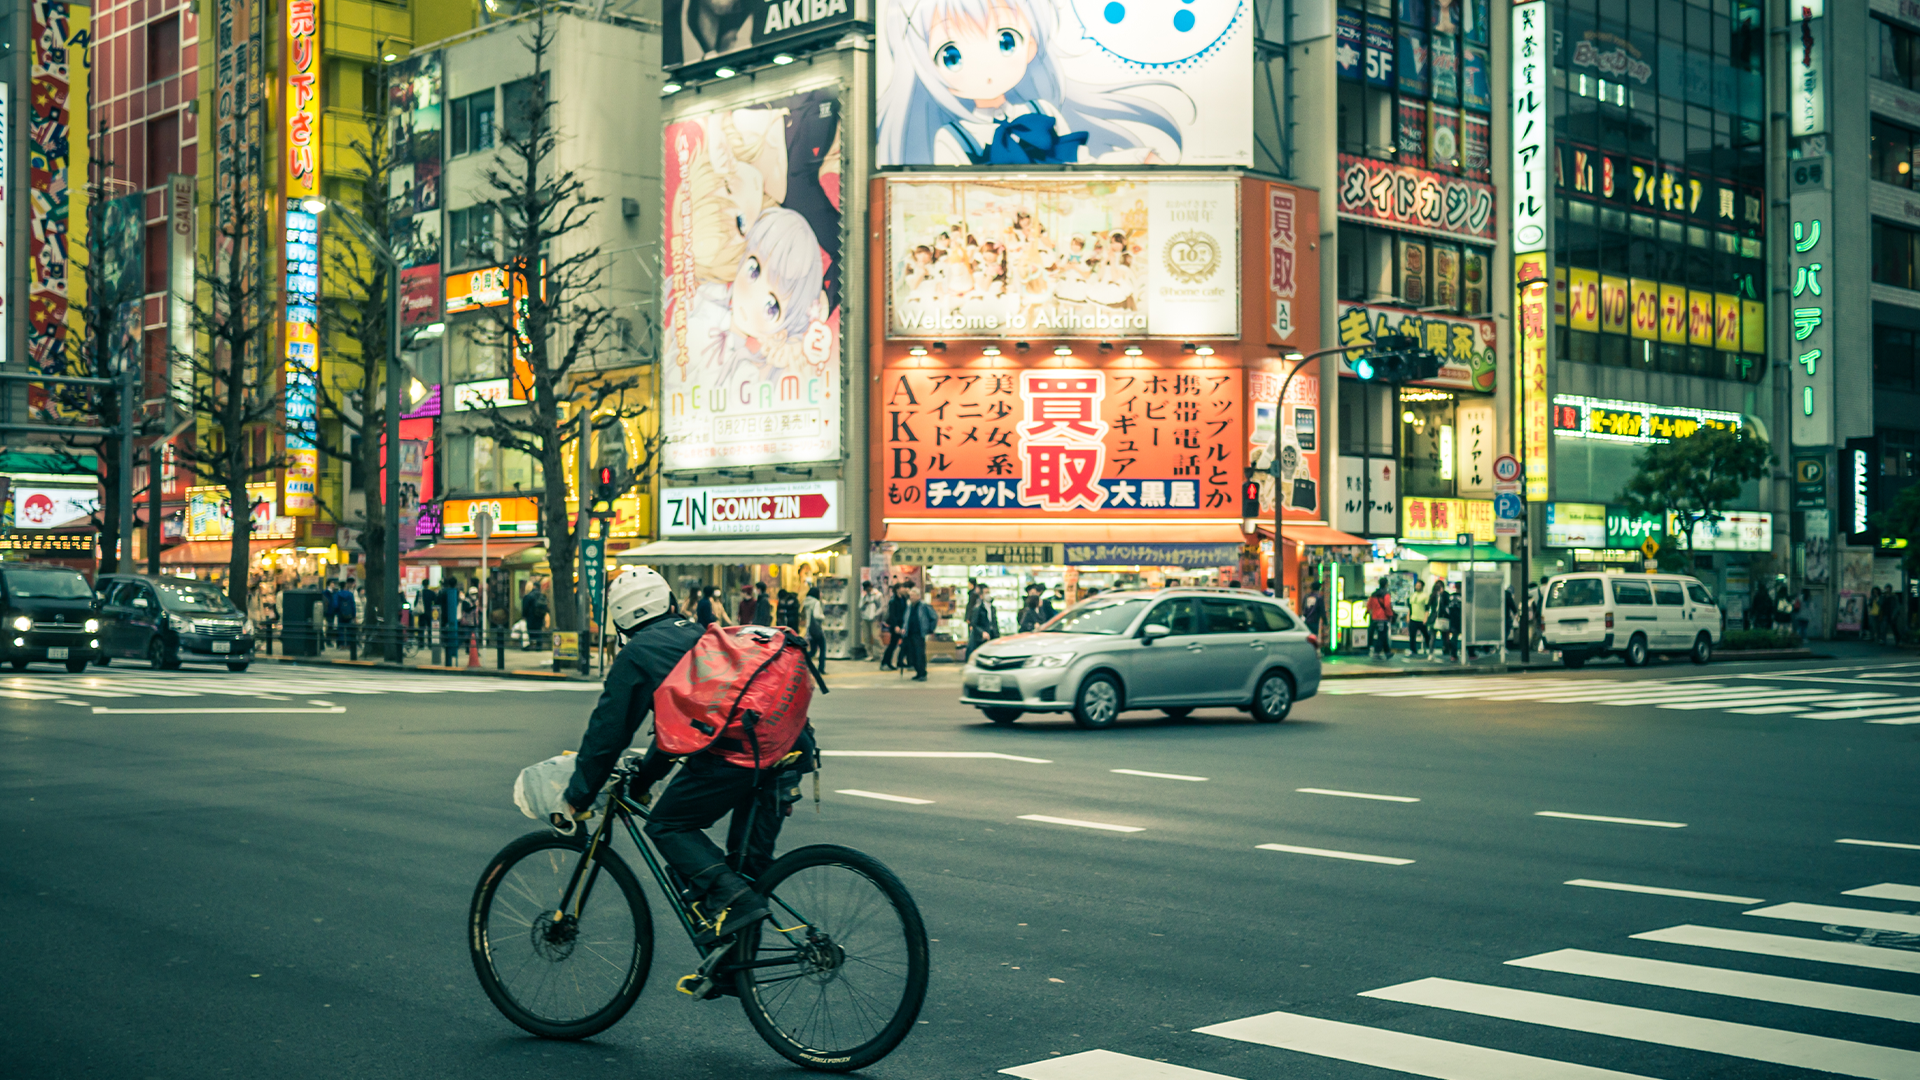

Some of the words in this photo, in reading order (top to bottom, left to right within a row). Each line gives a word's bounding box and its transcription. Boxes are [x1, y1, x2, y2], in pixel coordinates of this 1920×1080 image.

[764, 0, 848, 35] AKIBA
[1366, 47, 1393, 81] 5F
[175, 182, 192, 236] GAME
[1341, 163, 1491, 234] メイドカジノ
[1632, 165, 1702, 214] フィギュア
[1271, 191, 1296, 298] 買取
[898, 308, 998, 330] Welcome
[1005, 312, 1027, 330] to
[1033, 307, 1148, 330] Akihabara
[1279, 303, 1288, 331] 入口
[1793, 219, 1822, 416] リバティー
[1533, 348, 1545, 393] TAX
[926, 374, 953, 472] アイドル
[956, 374, 984, 448] アニメ
[984, 374, 1015, 475] 美少女系
[1111, 375, 1140, 477] フィギュア
[1142, 375, 1168, 447] ホビー
[1172, 374, 1201, 476] 携帯電話
[1532, 401, 1547, 458] FREE
[1017, 370, 1108, 511] 買取
[1204, 375, 1233, 509] アップルとか
[1471, 424, 1482, 485] ルノアール
[287, 480, 315, 494] AKIBA
[1500, 461, 1514, 475] 40
[1854, 449, 1868, 534] GALLERIA
[667, 491, 706, 531] ZIN
[713, 496, 771, 521] COMIC
[773, 496, 800, 519] ZIN
[927, 480, 1016, 507] チケット
[1110, 481, 1197, 507] 大黒屋
[1409, 500, 1449, 529] 免税
[1471, 501, 1491, 522] FREE
[1499, 499, 1511, 518] P
[712, 523, 760, 532] Akihabara
[1608, 515, 1661, 537] リバティー
[930, 547, 978, 555] TRANSFER
